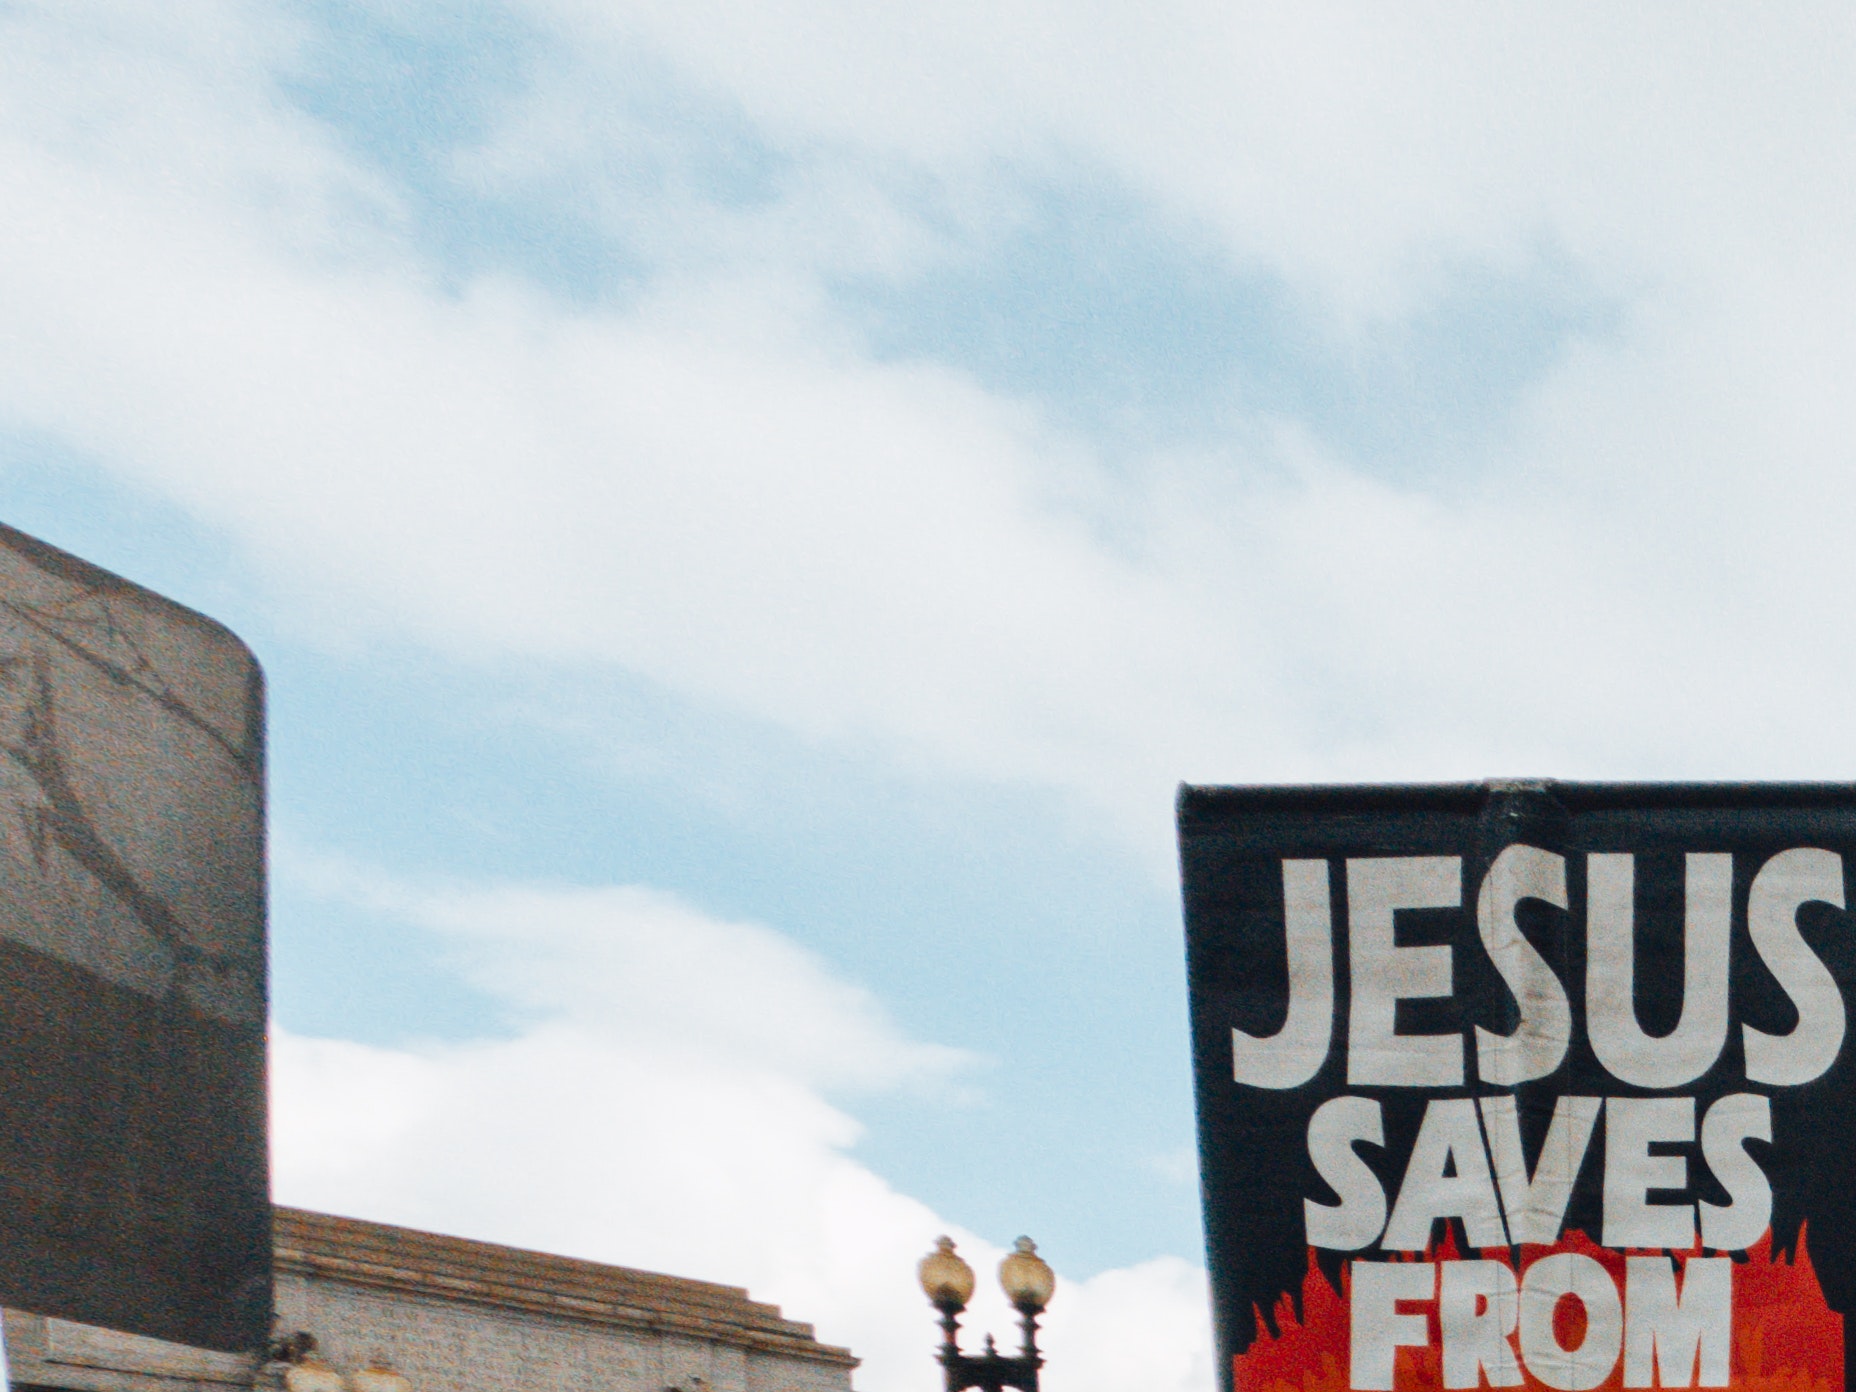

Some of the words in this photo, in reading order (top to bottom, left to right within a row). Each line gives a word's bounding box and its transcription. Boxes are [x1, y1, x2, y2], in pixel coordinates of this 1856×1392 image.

[1233, 844, 1849, 1090] JESUS
[1303, 1092, 1774, 1252] SAVES
[1350, 1252, 1732, 1392] FROM
